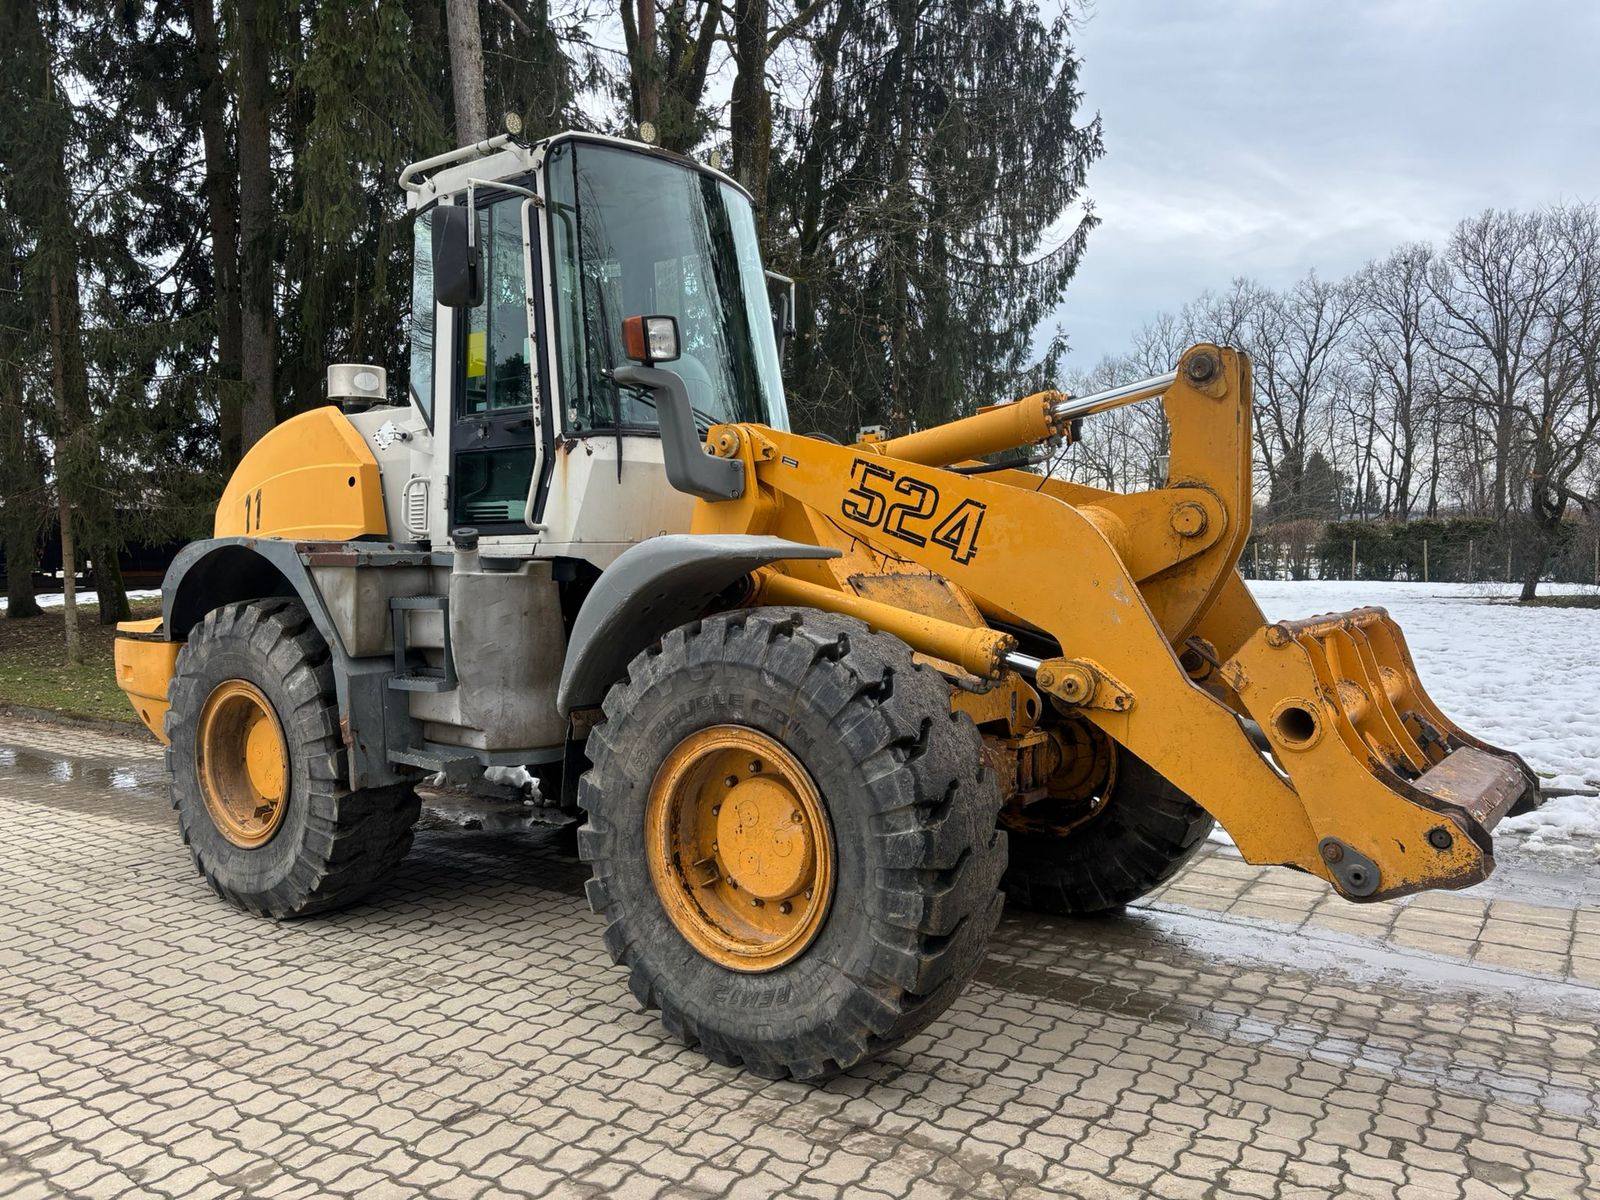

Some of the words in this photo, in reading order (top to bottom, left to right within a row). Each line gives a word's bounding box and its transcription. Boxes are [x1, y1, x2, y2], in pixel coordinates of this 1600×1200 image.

[245, 488, 262, 534] 11
[842, 457, 987, 566] 524
[649, 693, 745, 745] DOUBLE
[751, 699, 817, 749] COIN
